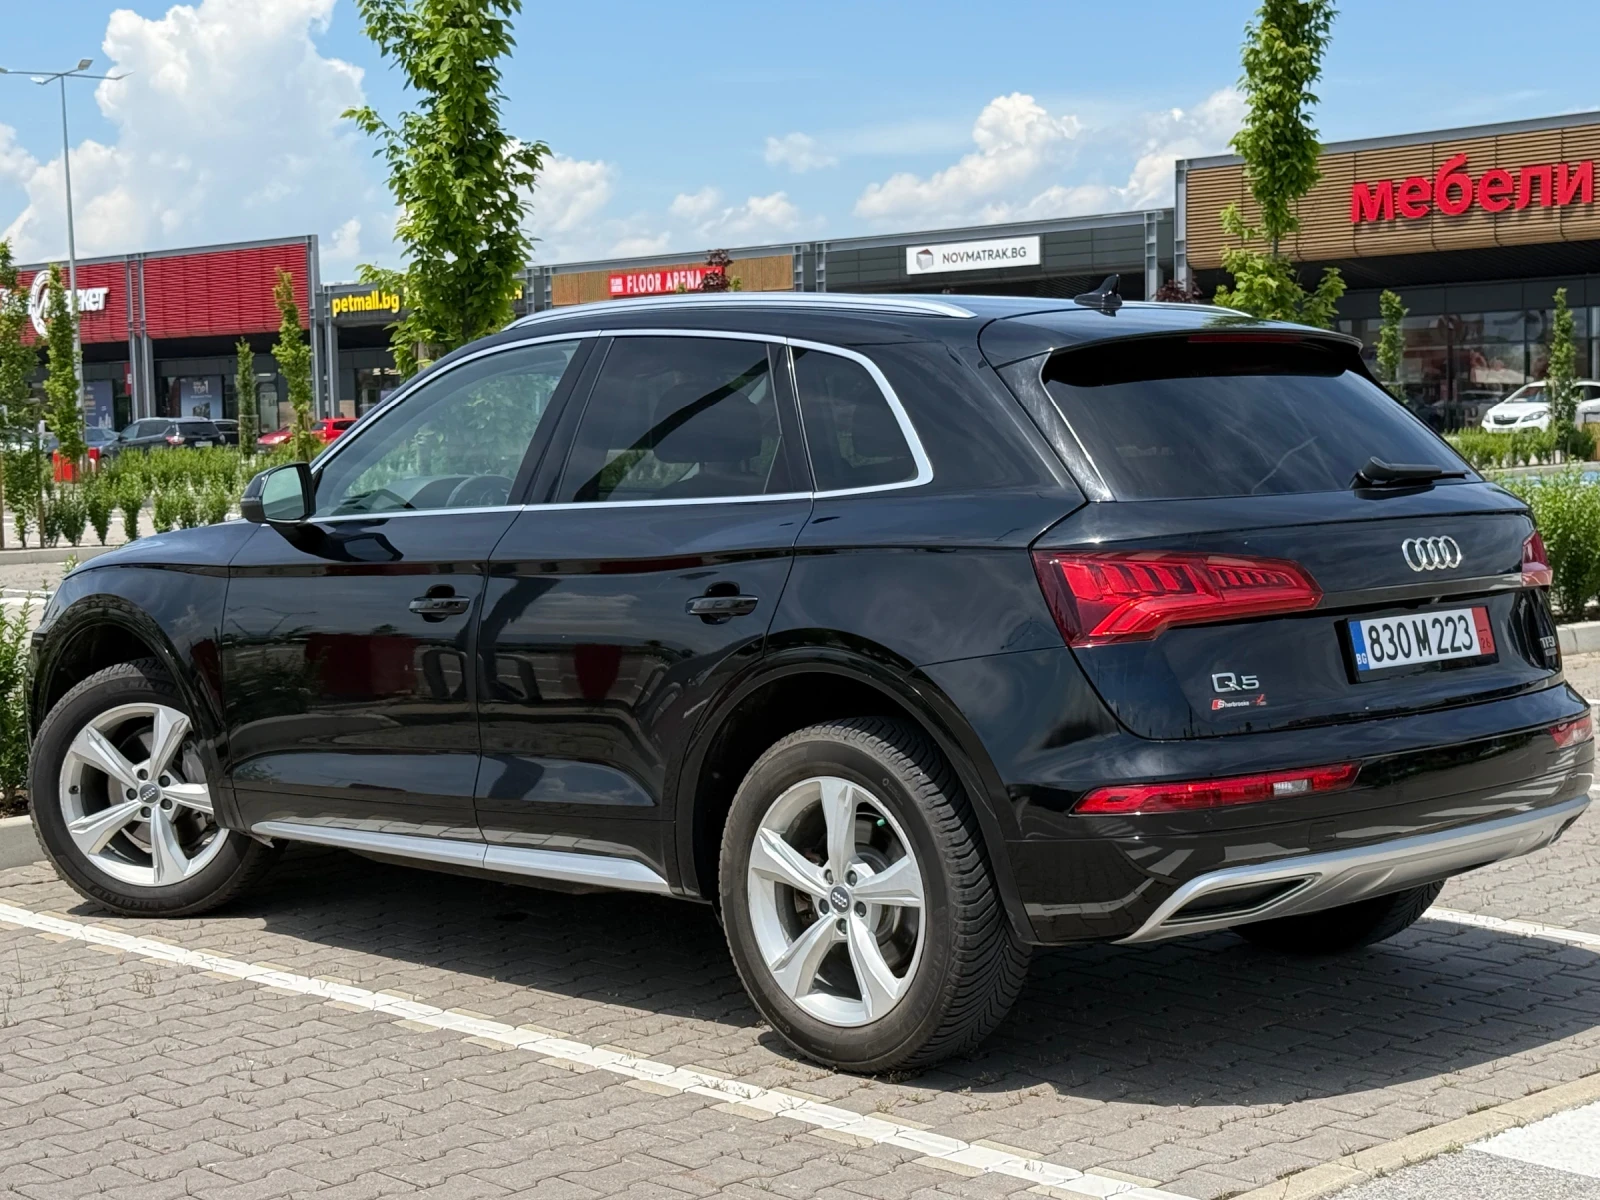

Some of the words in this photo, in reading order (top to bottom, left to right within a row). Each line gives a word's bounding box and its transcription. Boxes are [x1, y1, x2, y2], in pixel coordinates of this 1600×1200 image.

[1350, 152, 1594, 223] мебели
[942, 246, 1027, 264] NOVMATRAK.BG
[626, 273, 661, 293] FLOOR
[332, 290, 400, 317] petmall.bg
[1368, 622, 1412, 662] 830
[1412, 619, 1433, 657] M
[1431, 614, 1473, 655] 223
[1356, 653, 1368, 665] BG
[1211, 672, 1260, 693] Q5
